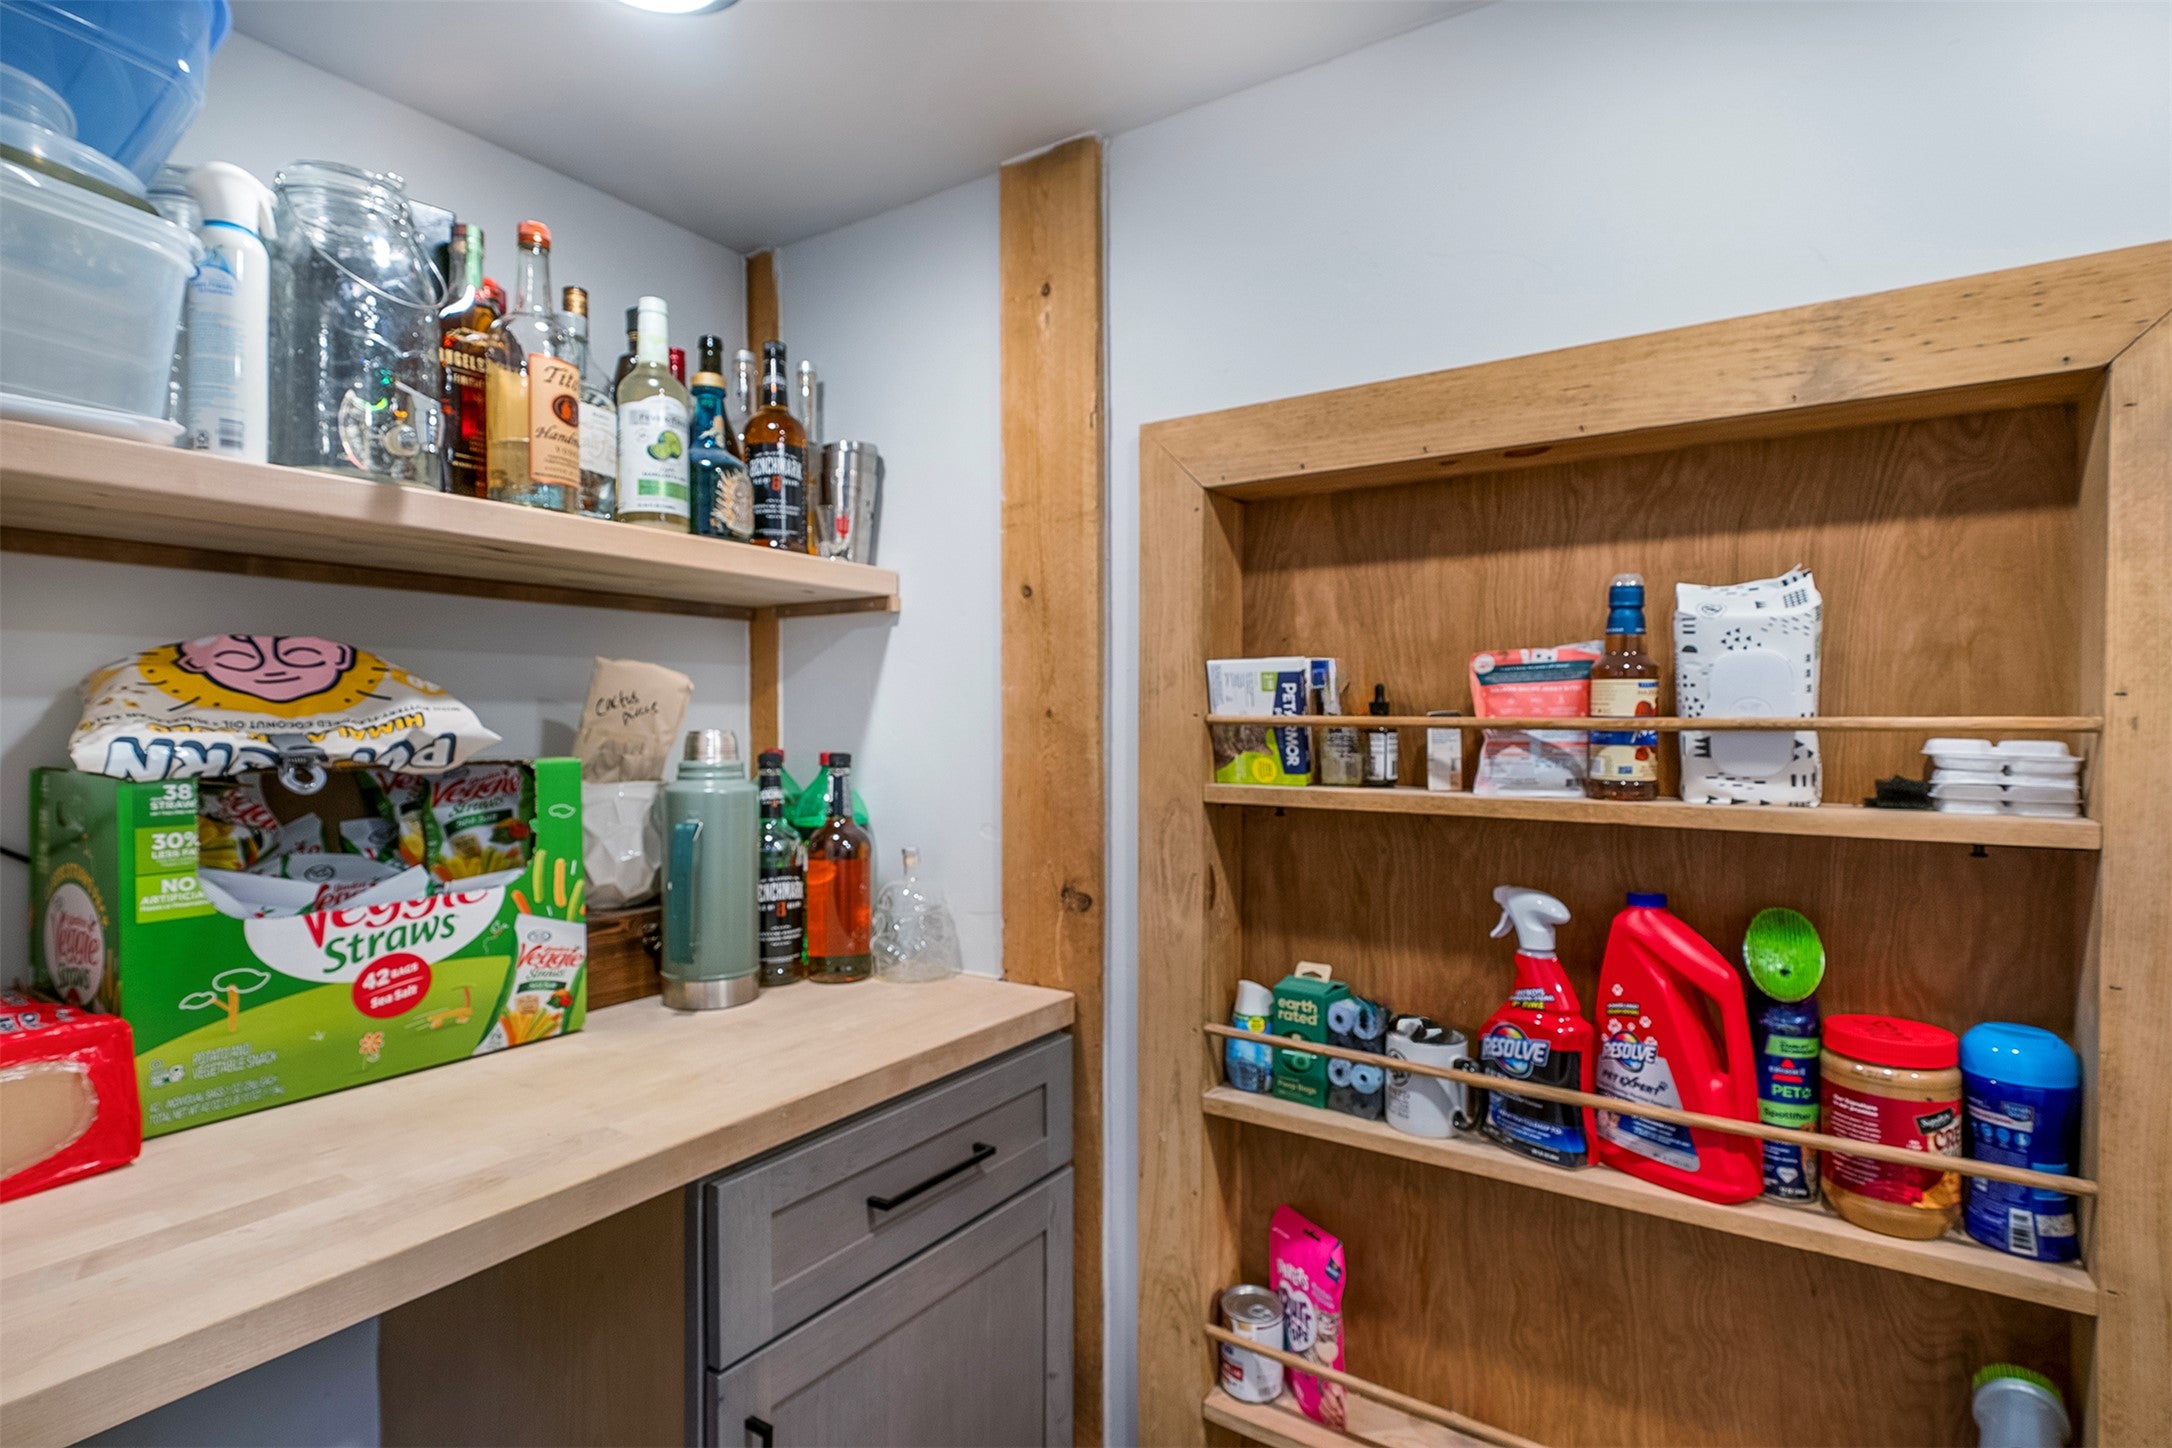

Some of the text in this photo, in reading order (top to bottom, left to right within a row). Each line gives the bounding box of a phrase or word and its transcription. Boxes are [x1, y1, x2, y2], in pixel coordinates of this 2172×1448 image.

[248, 719, 314, 731] COCONUT
[162, 782, 194, 801] 38
[151, 831, 202, 850] 30%
[161, 876, 197, 894] NO
[322, 913, 459, 974] Straws
[361, 966, 391, 991] 42
[370, 983, 418, 1010] Sea Salt
[1277, 997, 1318, 1015] earth
[1277, 1009, 1318, 1026] rated
[1484, 1035, 1549, 1064] RESOLVE
[1603, 1041, 1657, 1064] RESOLVE
[1772, 1083, 1803, 1099] PET
